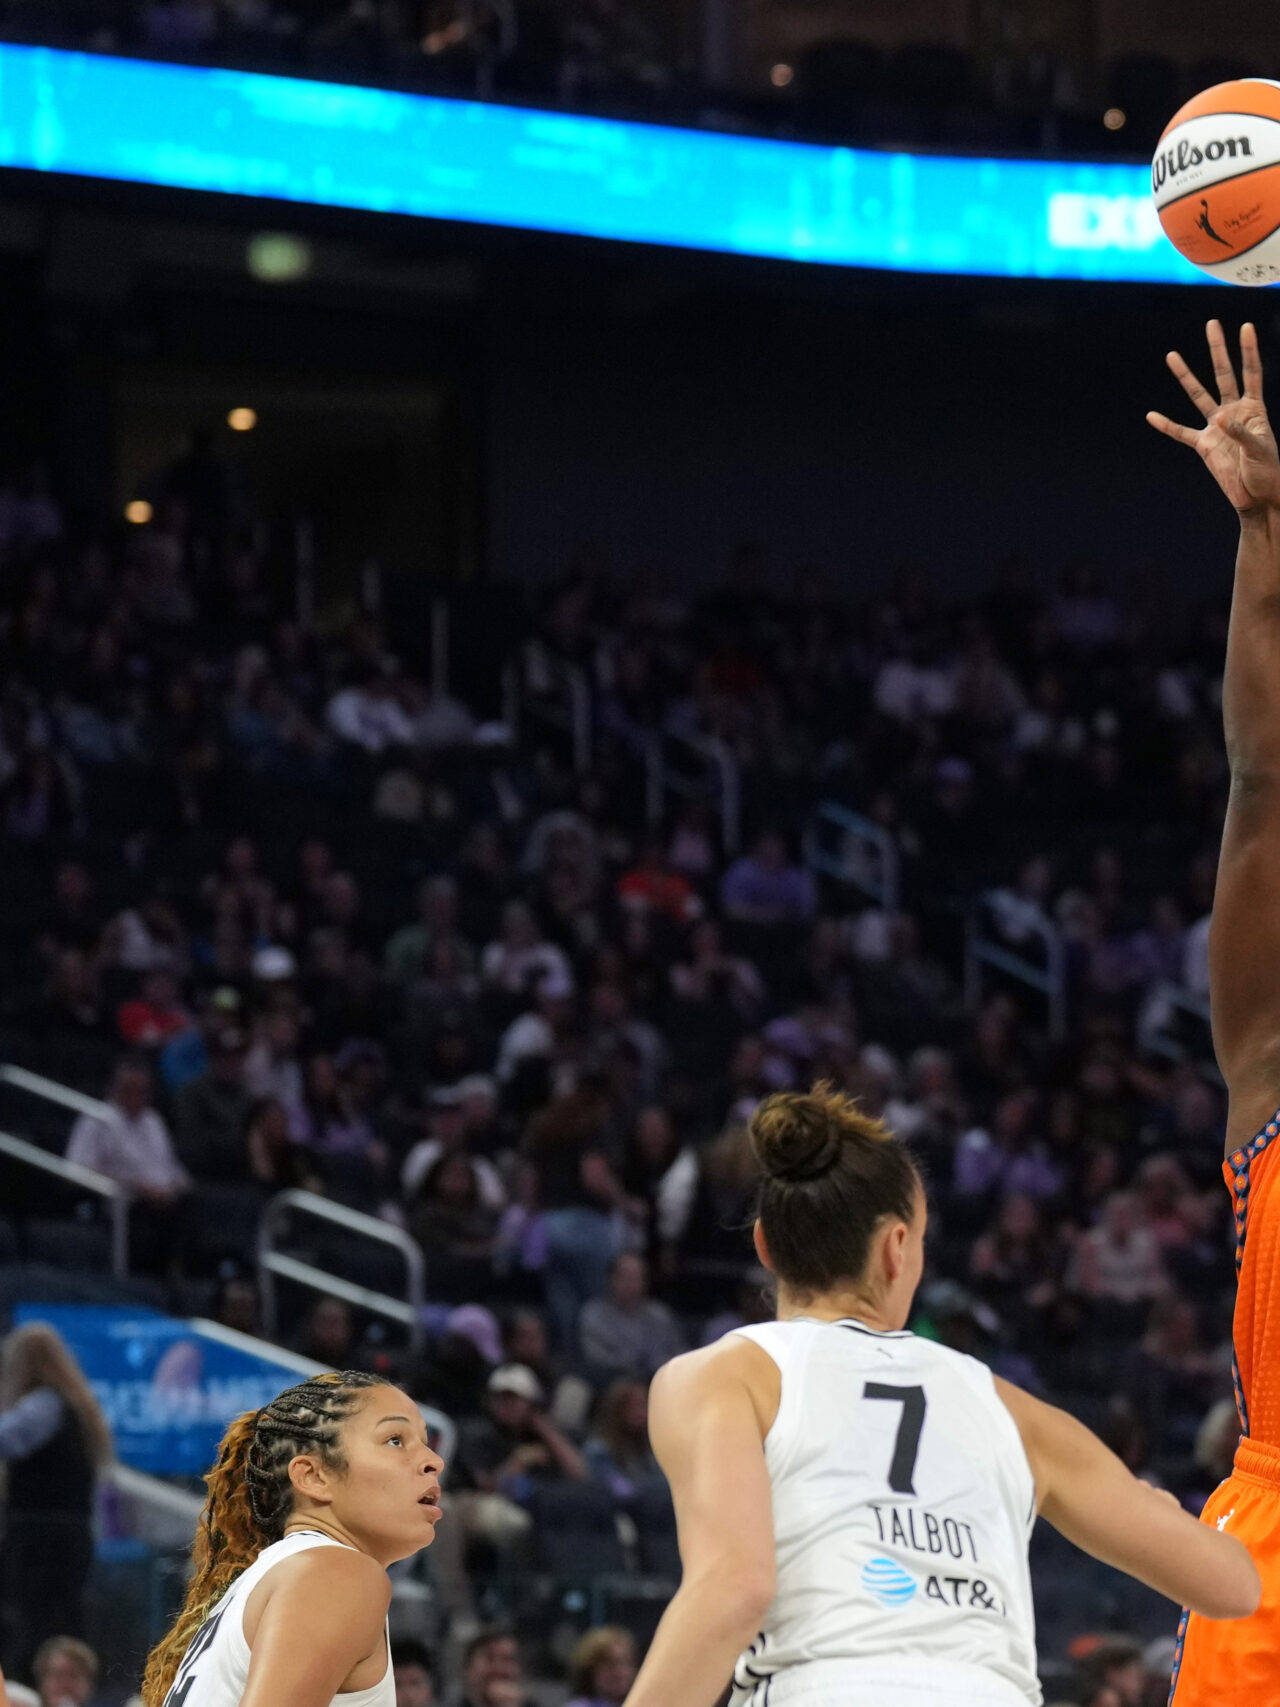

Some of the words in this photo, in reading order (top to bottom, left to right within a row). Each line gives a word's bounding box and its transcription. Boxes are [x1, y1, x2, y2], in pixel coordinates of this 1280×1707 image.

[1152, 134, 1252, 193] Wilson
[861, 1381, 928, 1497] 7
[867, 1503, 979, 1563] TALBOT
[926, 1575, 1007, 1618] AT&
